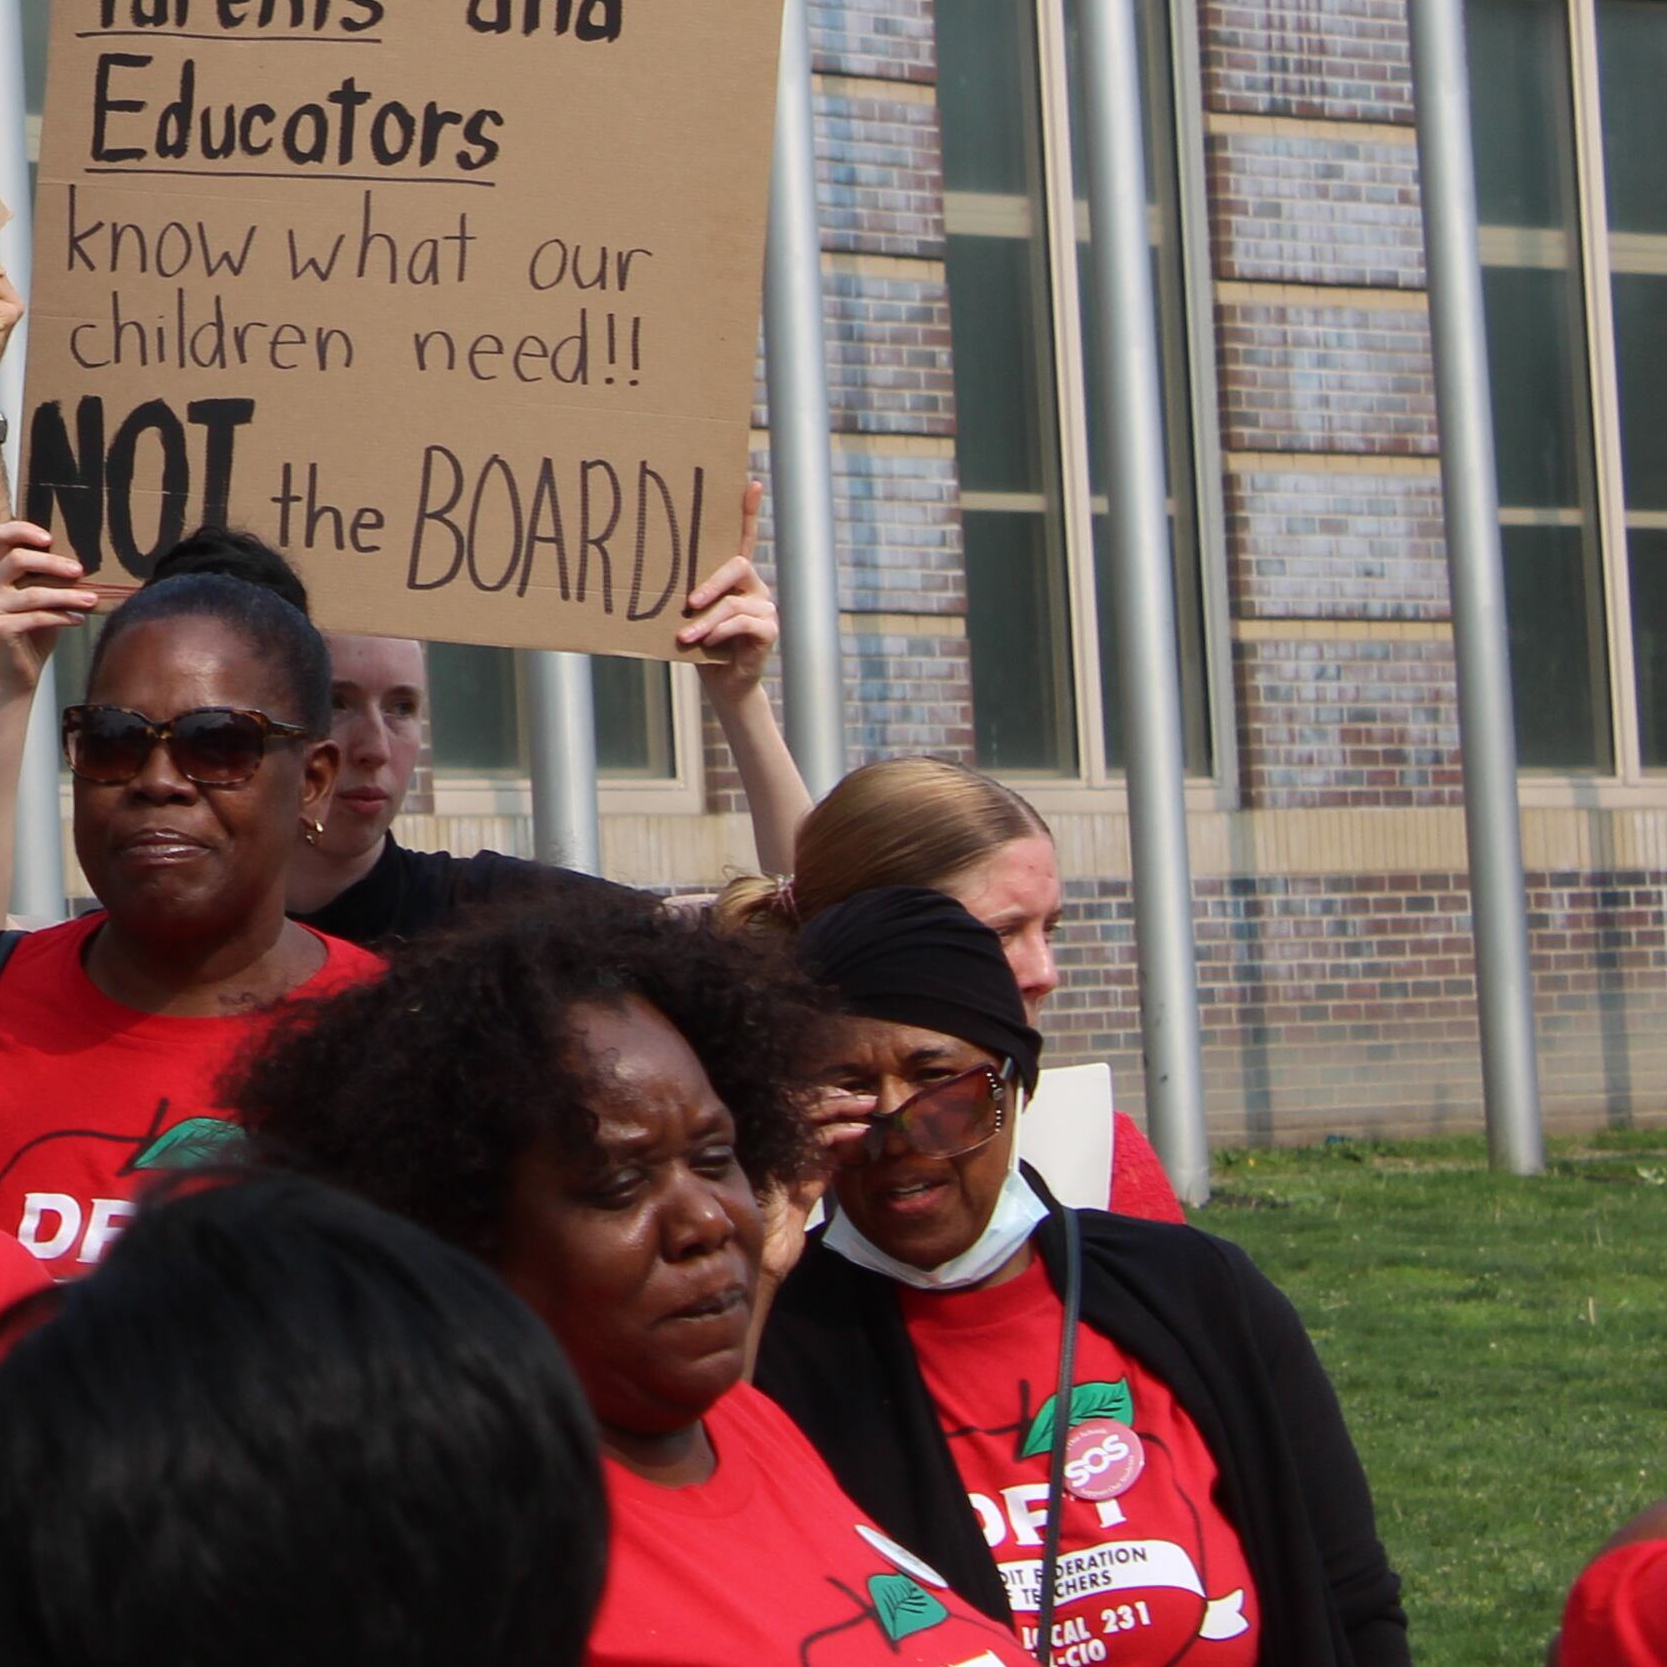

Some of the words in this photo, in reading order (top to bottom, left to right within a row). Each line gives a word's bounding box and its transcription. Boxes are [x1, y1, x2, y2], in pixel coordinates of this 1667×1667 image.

[91, 53, 505, 170] Educators
[67, 184, 257, 277] know
[288, 190, 477, 285] what
[528, 239, 653, 291] our
[70, 288, 353, 370] children
[414, 308, 642, 387] need!!
[28, 395, 255, 581] NOT
[271, 463, 385, 553] the
[407, 445, 704, 622] BOARD!
[17, 1192, 138, 1264] DF
[1064, 1434, 1129, 1488] SOS
[1101, 1600, 1151, 1634] 231
